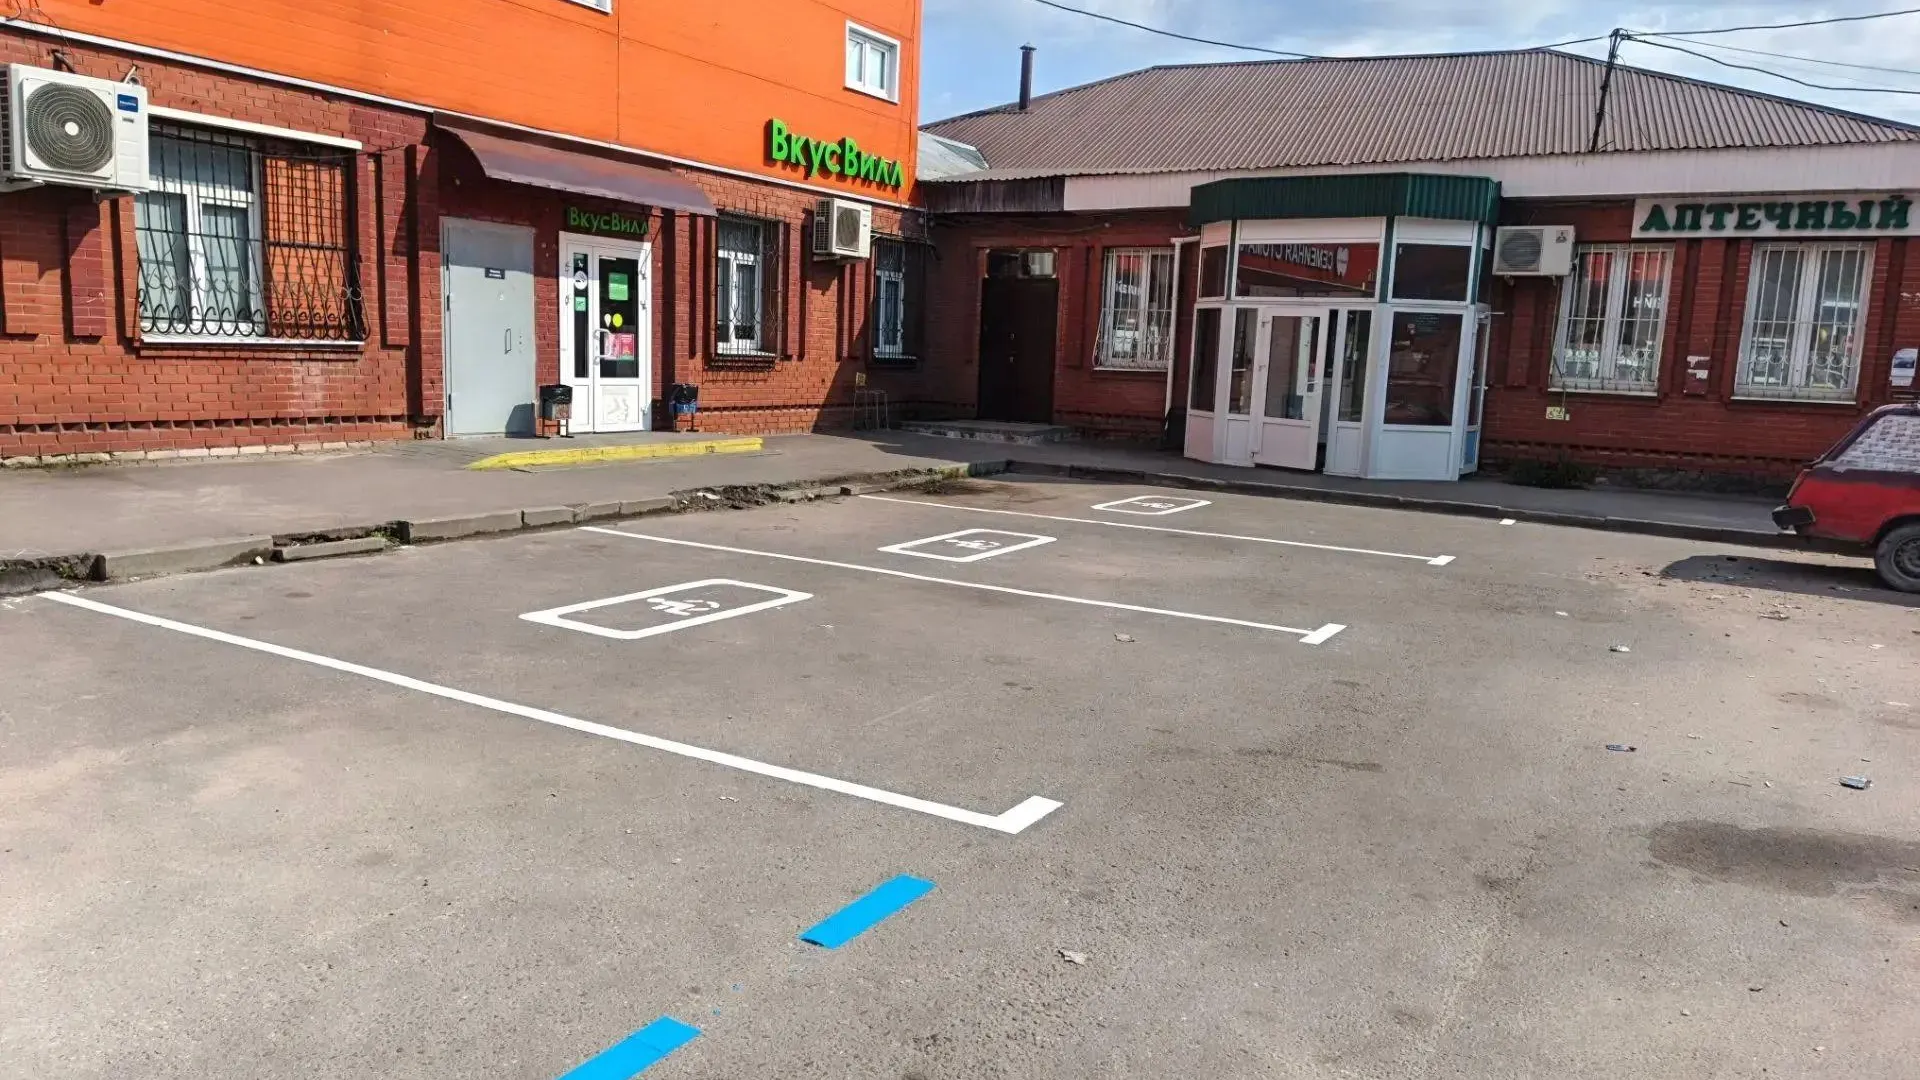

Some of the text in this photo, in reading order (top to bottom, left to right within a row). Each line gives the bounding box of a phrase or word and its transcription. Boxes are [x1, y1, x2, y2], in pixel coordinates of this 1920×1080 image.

[771, 117, 904, 188] ВкусВилл
[569, 206, 649, 234] ВкусВилл
[1639, 194, 1913, 231] АПТЕЧНЫЙ
